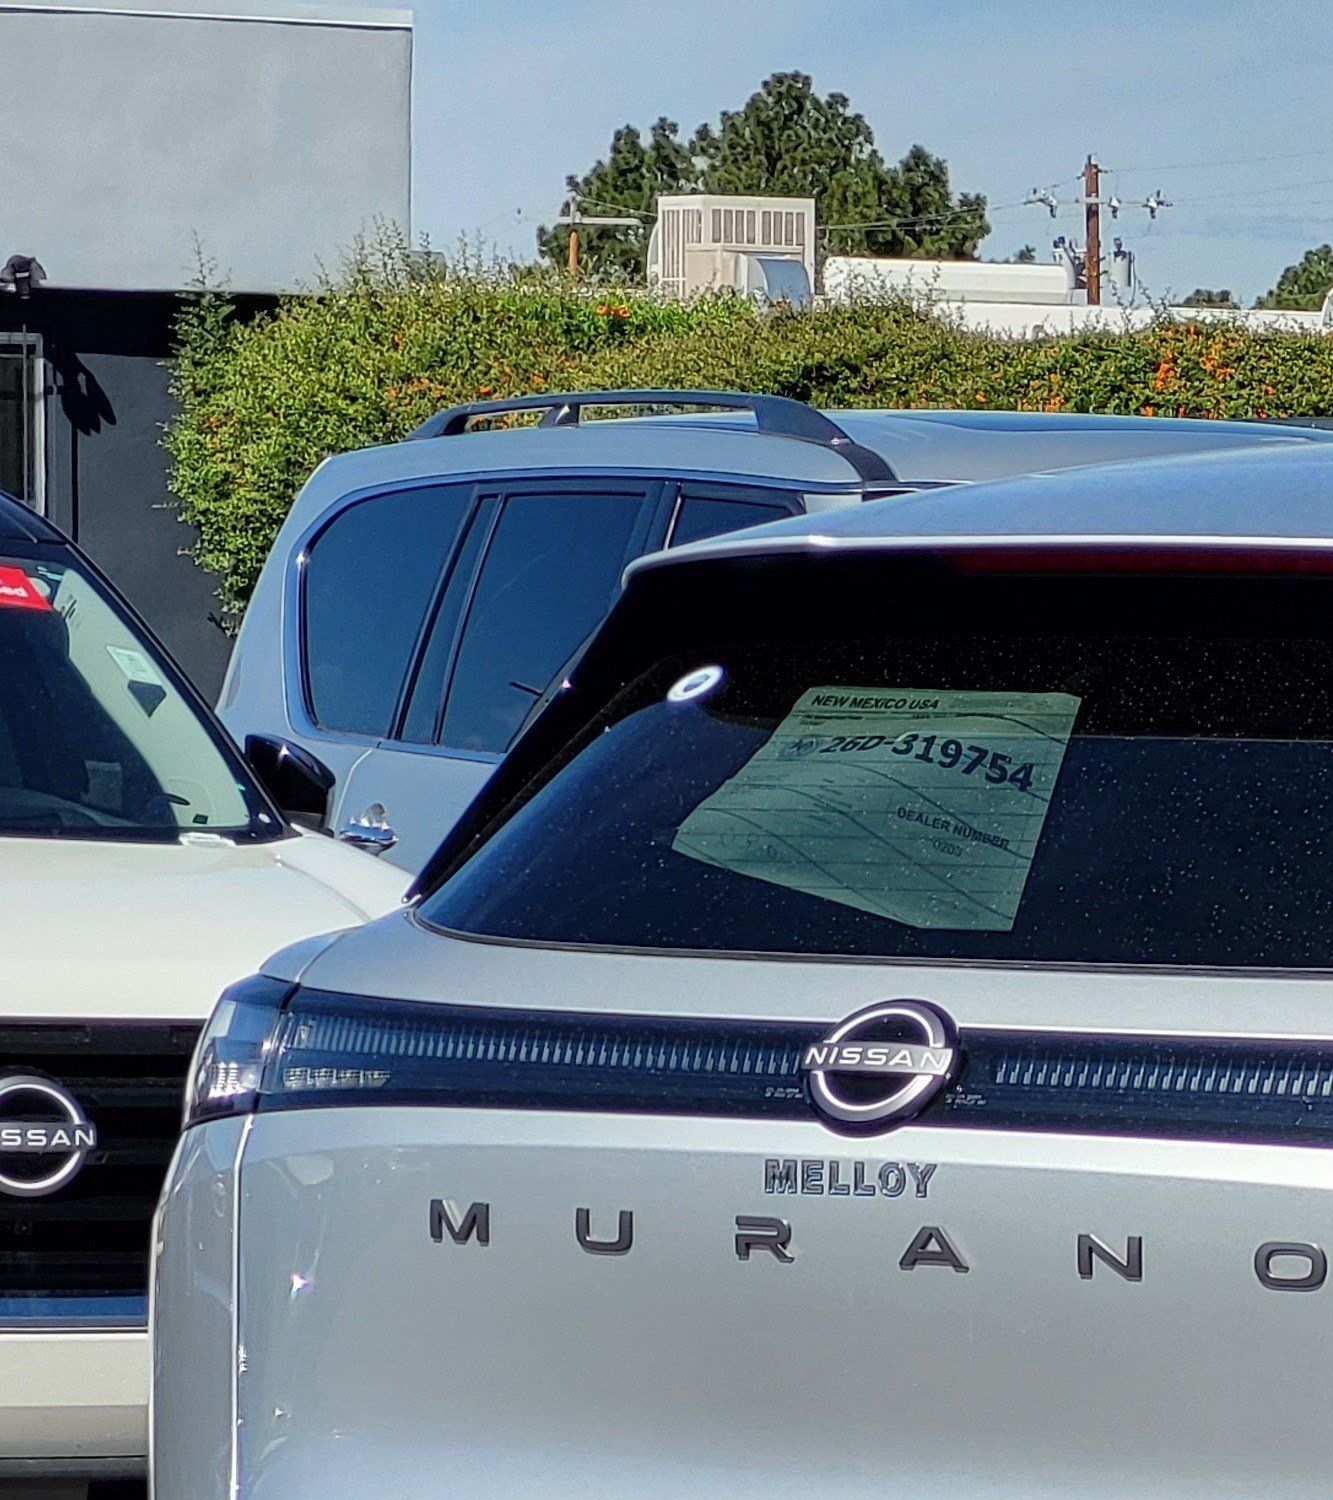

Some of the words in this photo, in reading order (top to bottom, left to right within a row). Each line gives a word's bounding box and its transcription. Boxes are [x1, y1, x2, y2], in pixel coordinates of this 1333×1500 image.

[811, 695, 849, 707] NEW
[850, 696, 906, 710] MEXICO
[908, 699, 939, 710] USA
[897, 807, 951, 832] DEALER
[952, 825, 1010, 850] NUMBER
[804, 1045, 952, 1075] NISSAN
[764, 1158, 938, 1198] MELLOY
[428, 1200, 1328, 1292] MURANO
